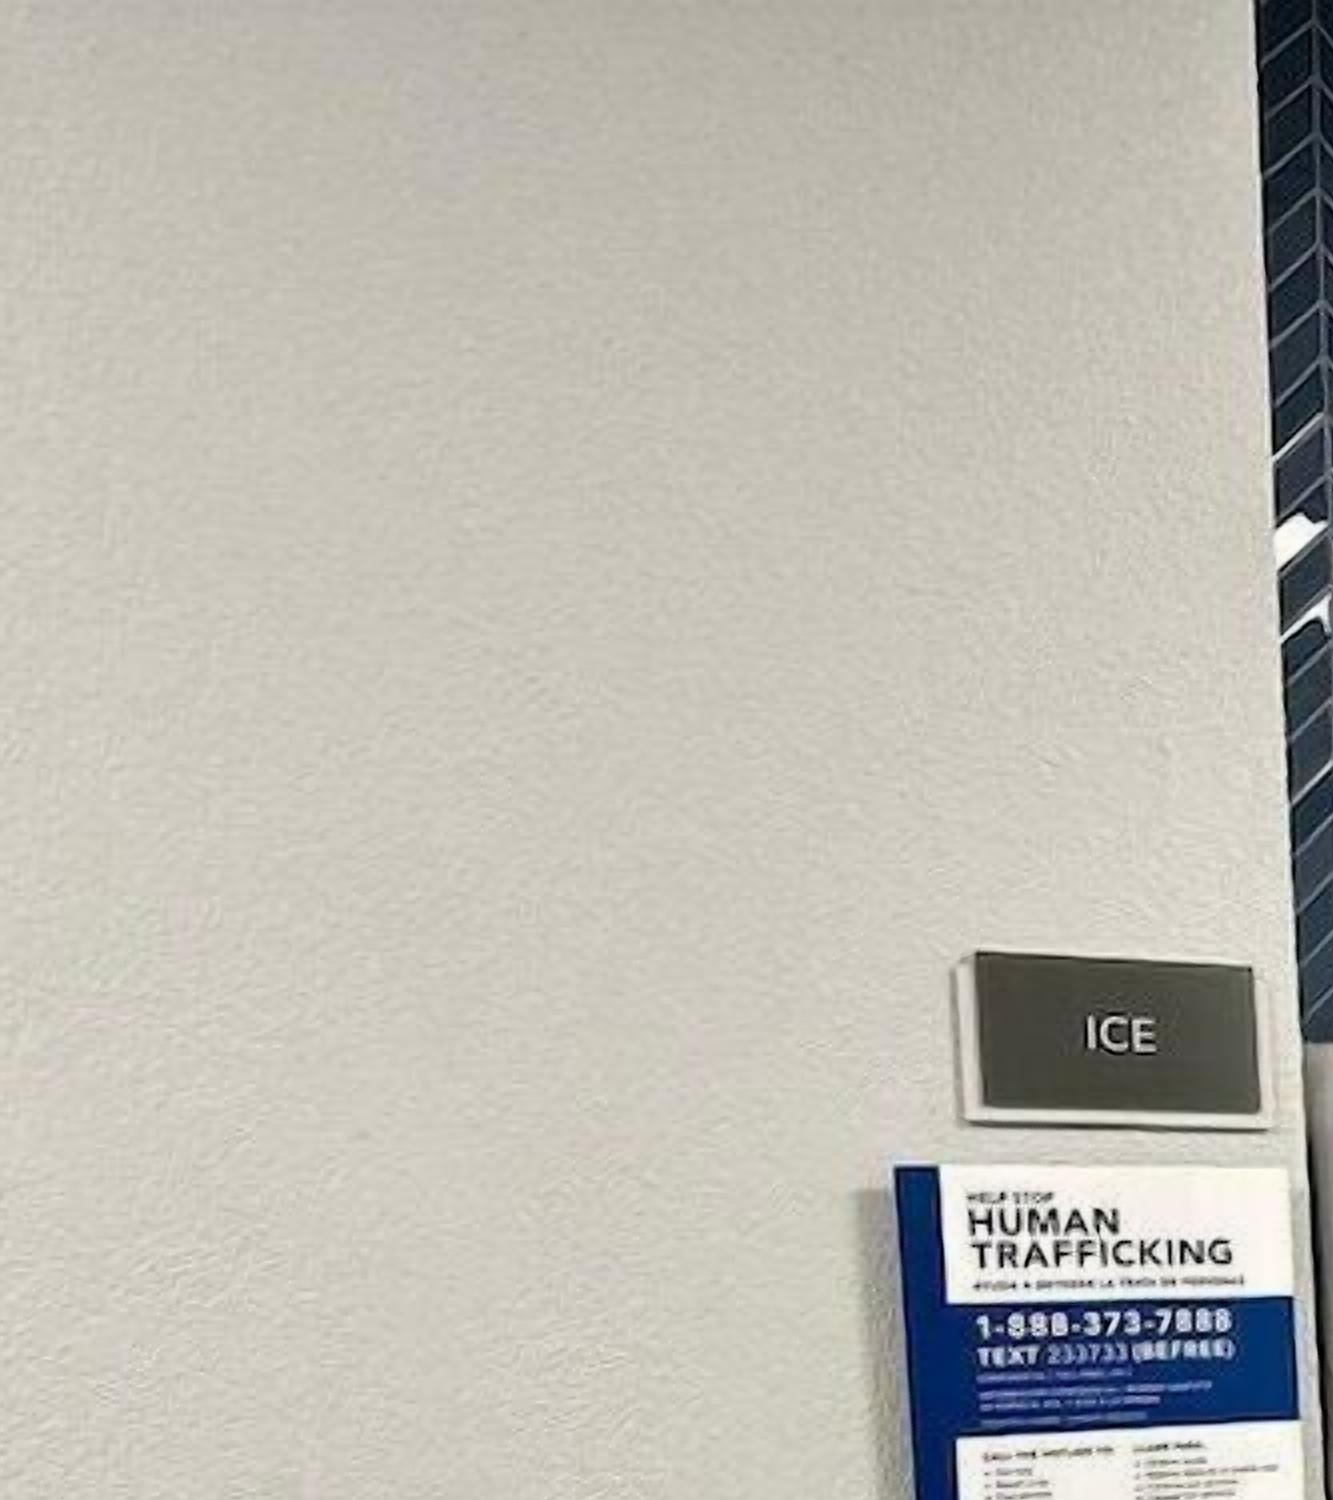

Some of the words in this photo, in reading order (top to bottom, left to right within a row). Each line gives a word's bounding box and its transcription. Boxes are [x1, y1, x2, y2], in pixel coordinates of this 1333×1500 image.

[1087, 1014, 1158, 1053] ICE
[967, 1208, 1121, 1236] HUMAN
[970, 1239, 1234, 1270] TRAFFICKING
[976, 1345, 1041, 1368] TEXT
[1046, 1342, 1129, 1365] 233733
[1131, 1338, 1237, 1364] (BEFREE)
